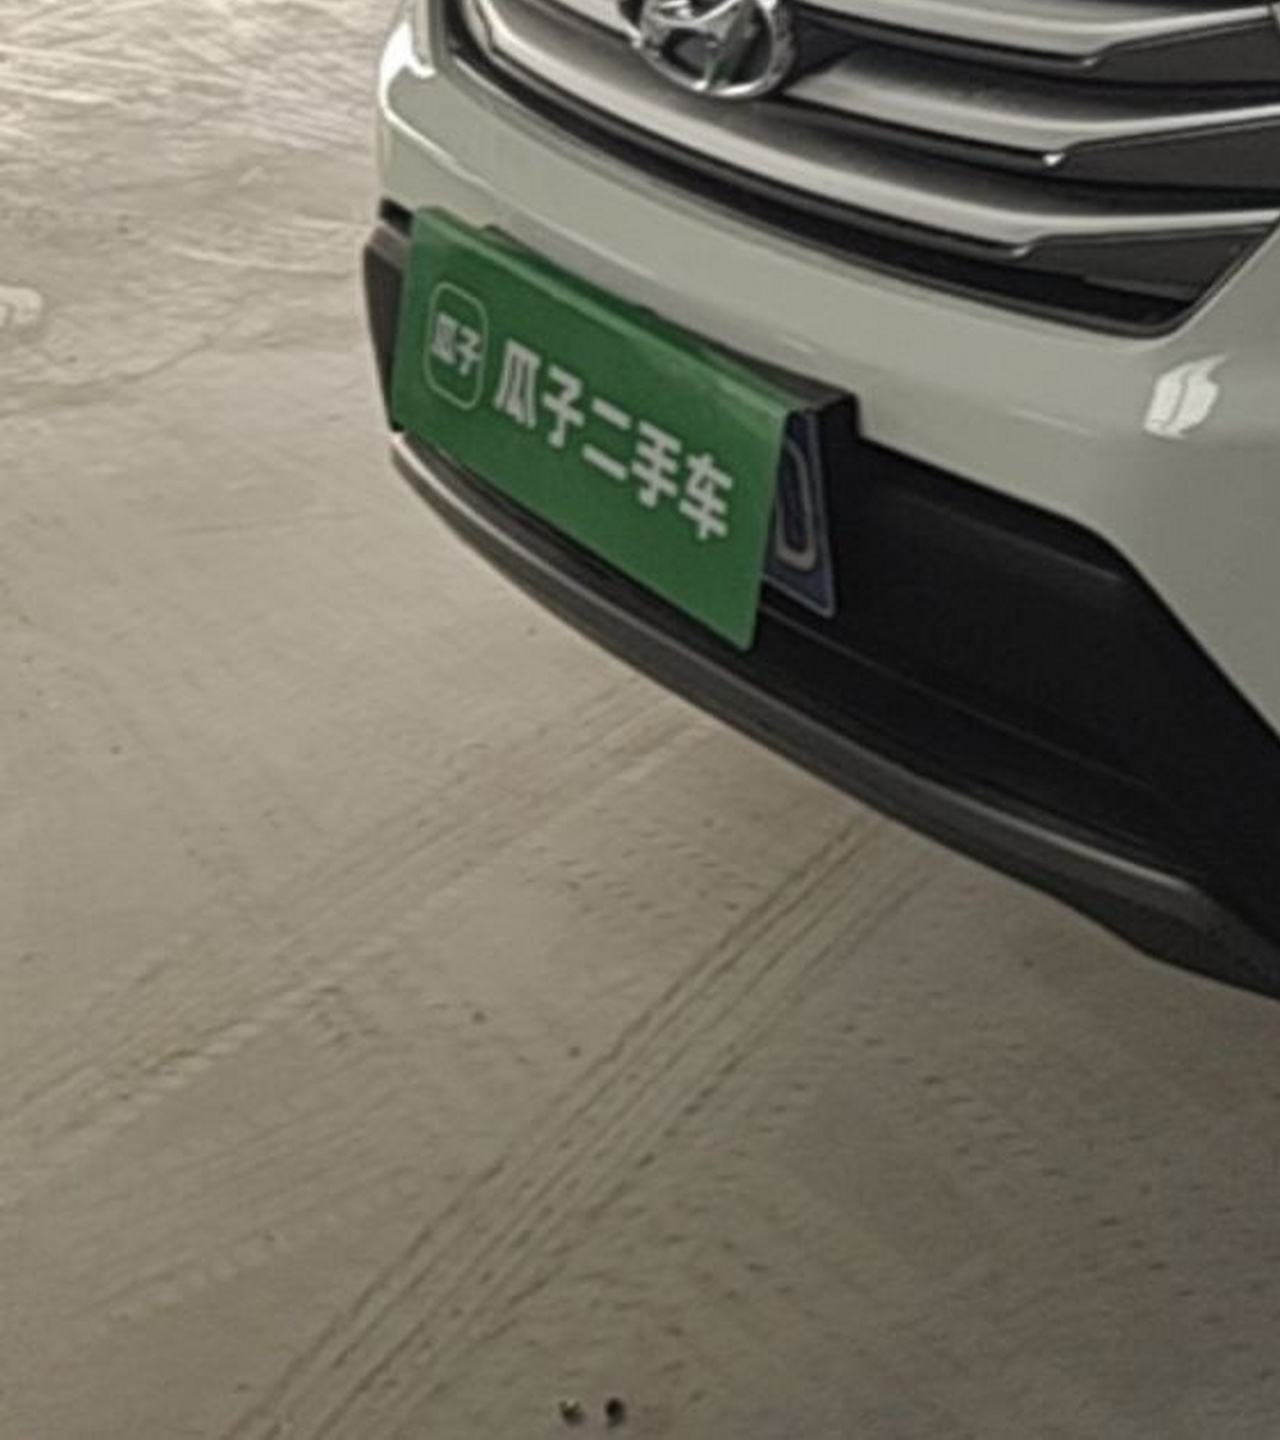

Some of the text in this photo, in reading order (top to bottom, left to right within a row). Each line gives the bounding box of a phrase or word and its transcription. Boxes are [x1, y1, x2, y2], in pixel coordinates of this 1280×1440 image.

[493, 338, 733, 541] 瓜子二手车
